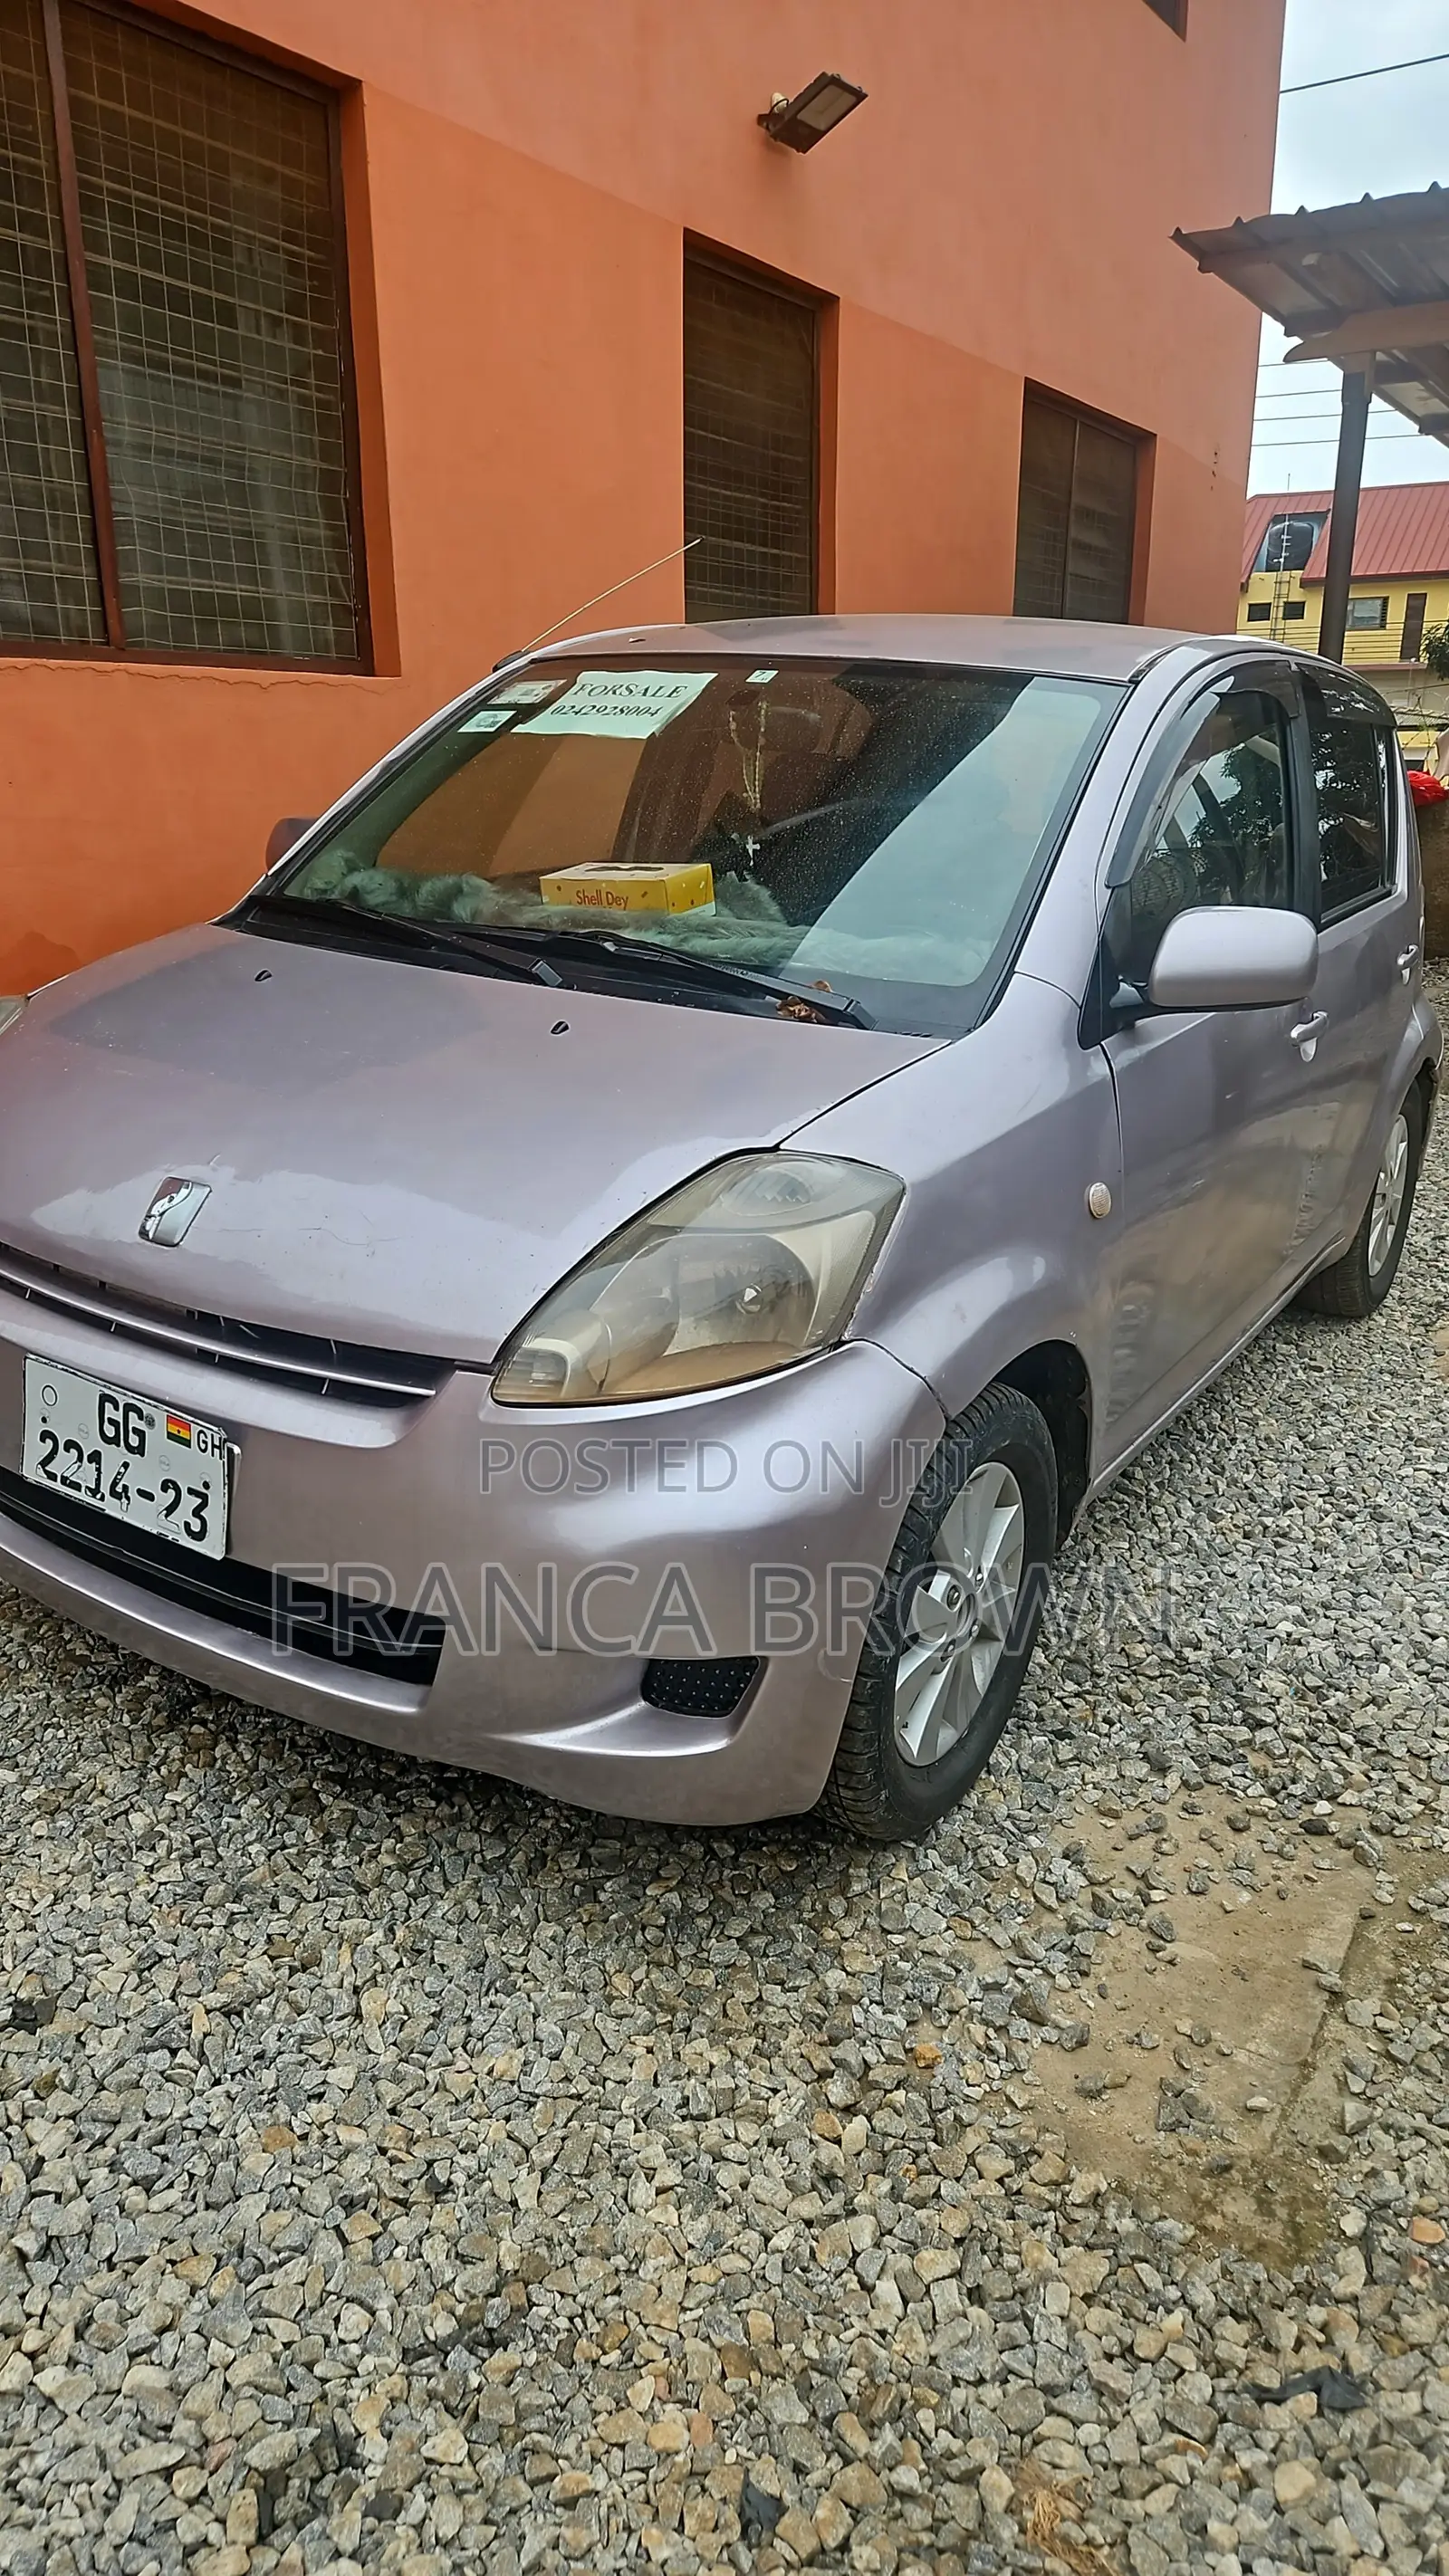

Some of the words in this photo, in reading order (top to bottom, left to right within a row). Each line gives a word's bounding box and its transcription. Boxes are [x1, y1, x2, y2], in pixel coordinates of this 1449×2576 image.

[572, 683, 688, 699] FORSALE
[550, 704, 664, 717] 0242928004
[575, 889, 603, 906] Shell
[605, 890, 629, 911] Dey
[98, 1392, 147, 1458] GG
[197, 1429, 225, 1461] GH
[36, 1429, 210, 1543] 2214-23
